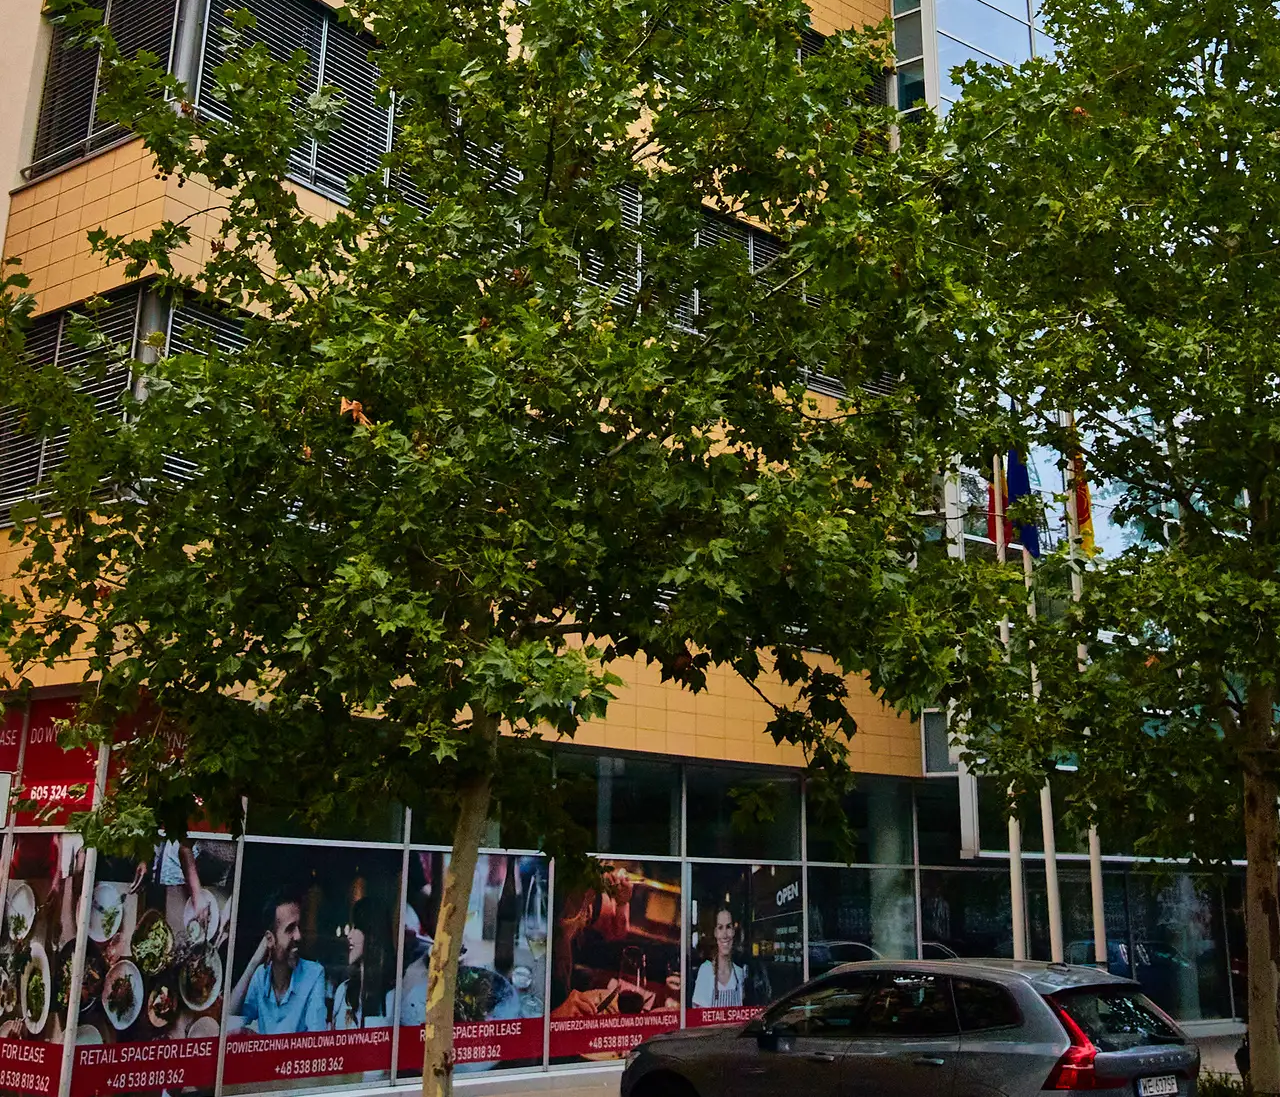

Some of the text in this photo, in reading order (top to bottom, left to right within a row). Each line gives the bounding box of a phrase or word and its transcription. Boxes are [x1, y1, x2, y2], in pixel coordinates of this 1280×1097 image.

[30, 728, 44, 744] DO
[30, 786, 48, 800] 605
[49, 785, 68, 799] 324
[776, 881, 799, 906] OPEN
[550, 1014, 678, 1032] POWIERZCHNIA HANDLOWA DO WYNAJĘCIA
[702, 1010, 727, 1022] RETAIL
[727, 1008, 750, 1021] SPACE
[452, 1022, 522, 1040] SPACE FOR LEASE
[226, 1031, 390, 1054] POWIERZCHNIA HANDLOWA DO WYNAJĘCIA
[588, 1034, 643, 1049] +48 538 818 362
[1, 1043, 46, 1063] FOR LEASE
[79, 1041, 213, 1065] RETAIL SPACE FOR LEASE
[457, 1047, 472, 1060] 538
[472, 1045, 486, 1059] 818
[487, 1044, 501, 1058] 362
[274, 1056, 344, 1075] +48 538 818 362
[6, 1071, 21, 1088] 538
[21, 1073, 35, 1089] 818
[35, 1075, 50, 1092] 362
[106, 1068, 185, 1089] +48 538 818 362
